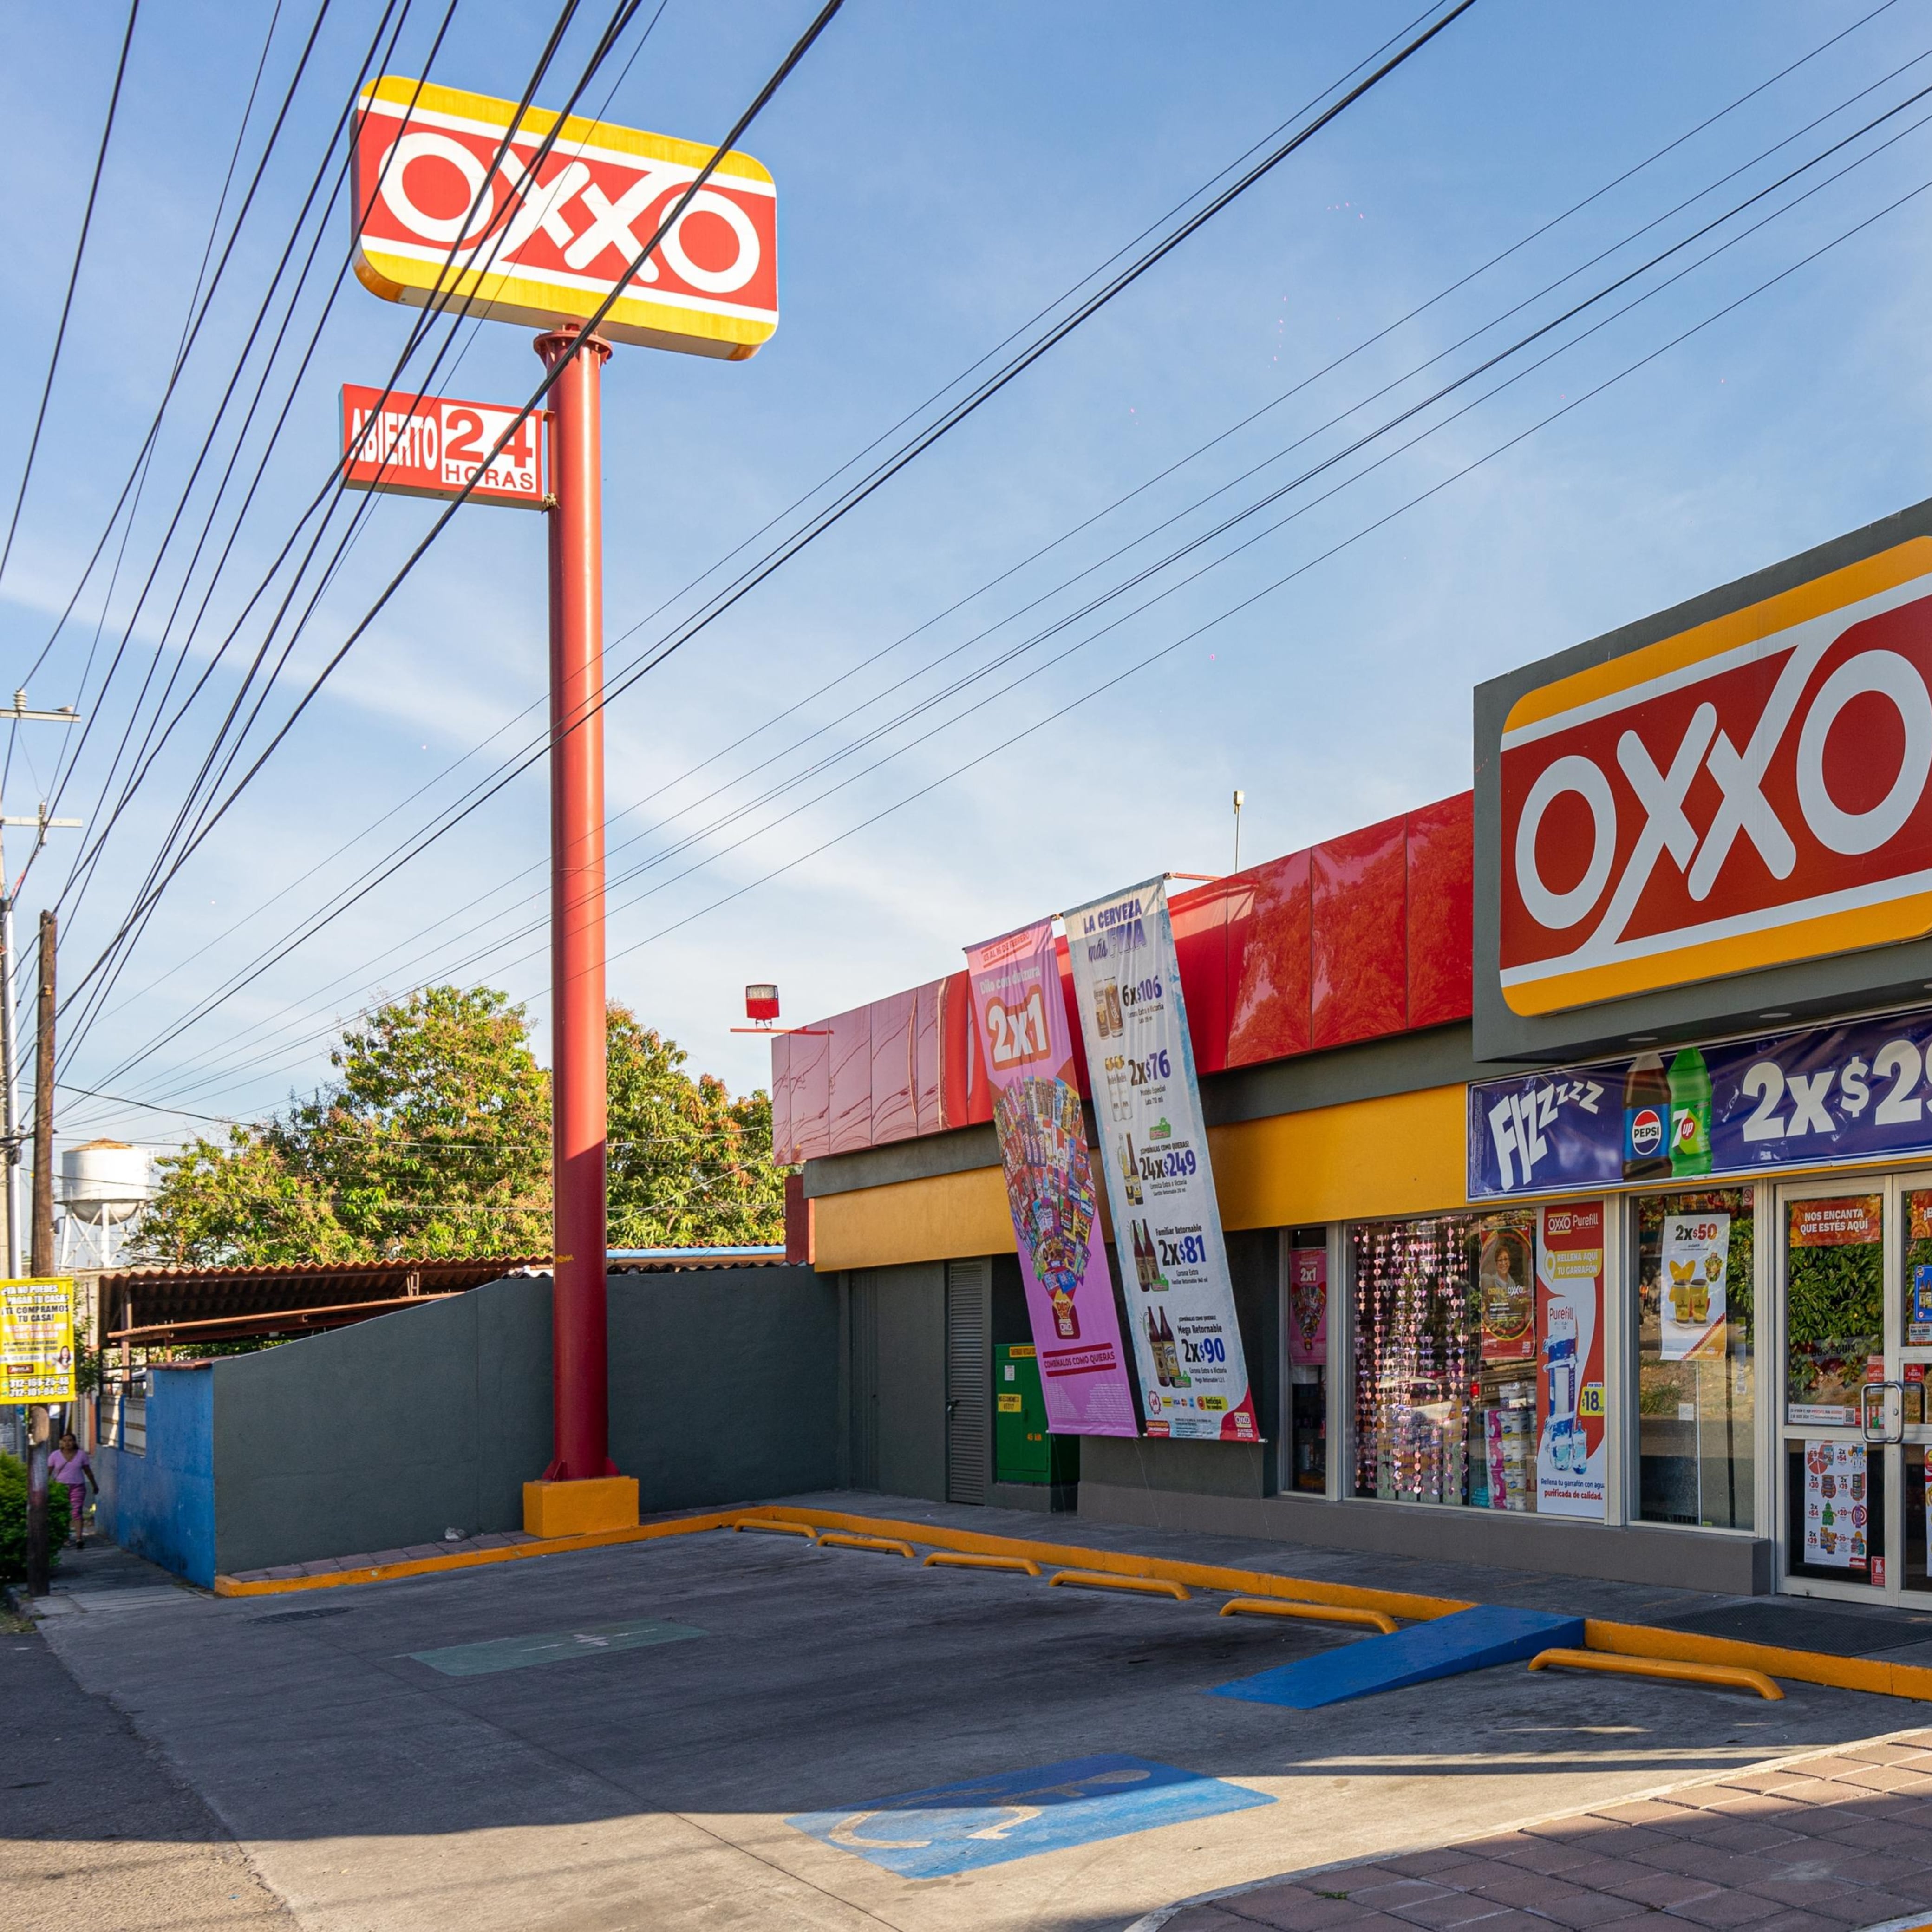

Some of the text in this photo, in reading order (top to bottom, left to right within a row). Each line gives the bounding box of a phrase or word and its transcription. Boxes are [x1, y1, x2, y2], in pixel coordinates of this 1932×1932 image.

[379, 132, 760, 294] OXXO
[349, 408, 533, 471] ABIERTO 24
[446, 464, 533, 490] HORAS
[1515, 625, 1932, 950] OXXO
[1083, 898, 1142, 934] LA CERVEZA
[1089, 938, 1108, 962] más
[996, 976, 1011, 989] con
[1122, 975, 1162, 1007] 6x$106
[988, 992, 1048, 1063] 2x1
[1128, 1049, 1171, 1086] 2x$76
[1743, 1039, 1932, 1142] 2x$2
[1634, 1127, 1659, 1138] PEPSI
[1139, 1149, 1196, 1181] 24x$249
[1548, 1213, 1599, 1232] OXXO Purefill
[1805, 1208, 1864, 1221] NOS ENCANTA
[1156, 1224, 1202, 1236] Familiar Retornable
[1675, 1223, 1717, 1240] 2x$50
[1801, 1218, 1868, 1235] QUE ESTÉS AQUÍ
[1158, 1235, 1206, 1266] 2x$81
[1557, 1250, 1598, 1262] RELLENA AQUÍ
[1300, 1267, 1316, 1281] 2x1
[1566, 1263, 1598, 1275] GARRAFÓN
[16, 1305, 69, 1314] COMPRAMOS
[31, 1314, 54, 1322] CASA!
[1550, 1306, 1573, 1321] Purefill
[1177, 1324, 1222, 1336] Mega Retornable
[1181, 1338, 1225, 1363] 2x$90
[1044, 1351, 1115, 1368] COMBÍNALOS COMO QUIERAS
[1564, 1480, 1584, 1488] garrafón
[1544, 1488, 1603, 1500] purificada de calidad.
